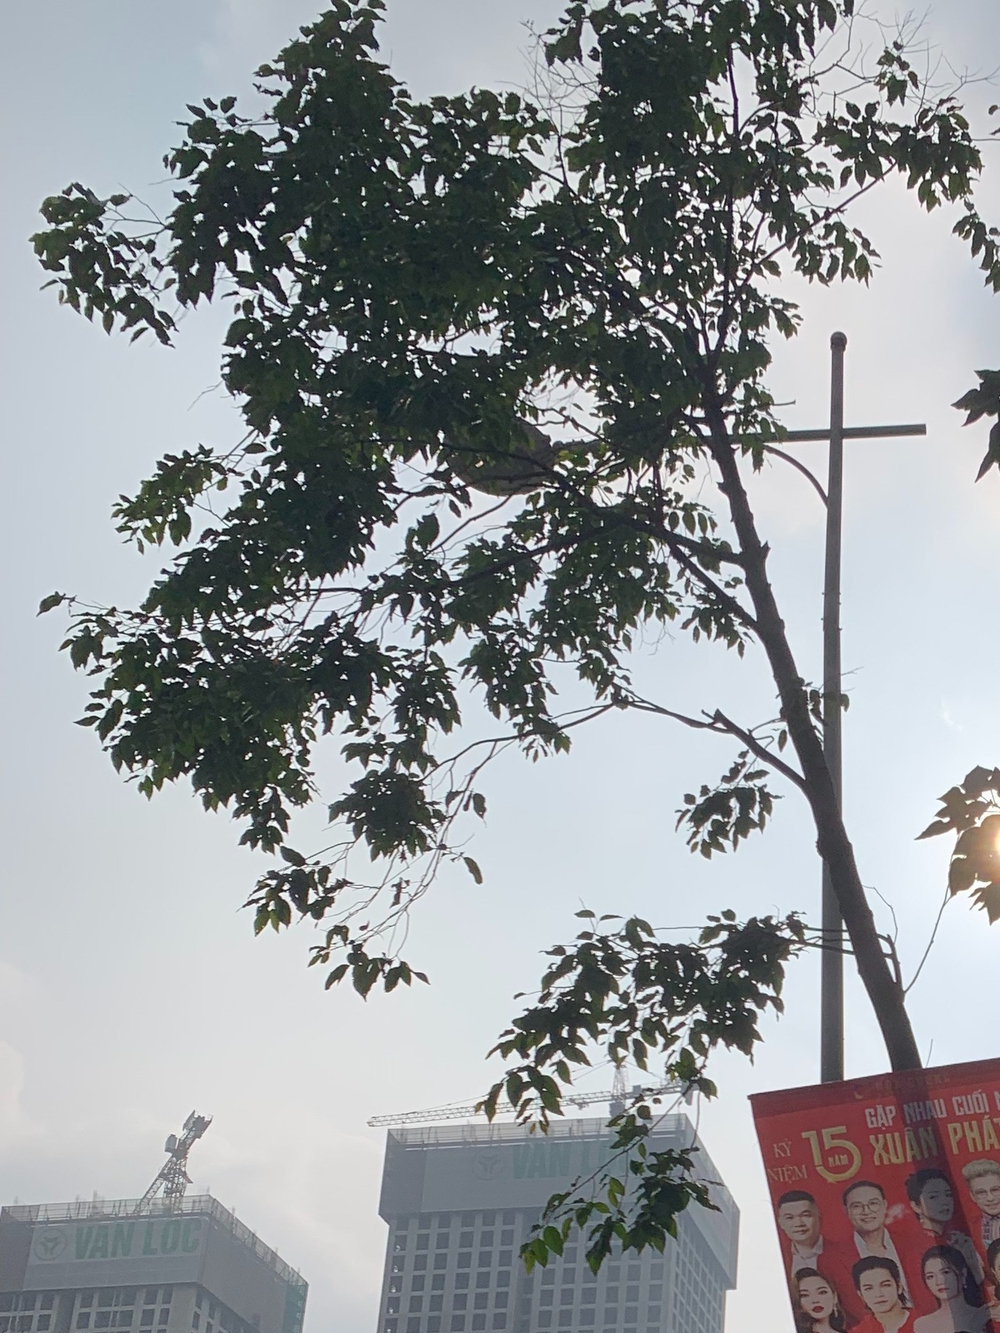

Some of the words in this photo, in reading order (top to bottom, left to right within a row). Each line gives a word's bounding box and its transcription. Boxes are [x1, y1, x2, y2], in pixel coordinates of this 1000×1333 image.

[864, 1104, 896, 1129] GẶP
[903, 1098, 947, 1123] NHAU
[951, 1089, 989, 1115] CUỐI
[772, 1141, 791, 1158] KỶ
[802, 1125, 861, 1182] 15
[869, 1126, 937, 1165] XUÂN
